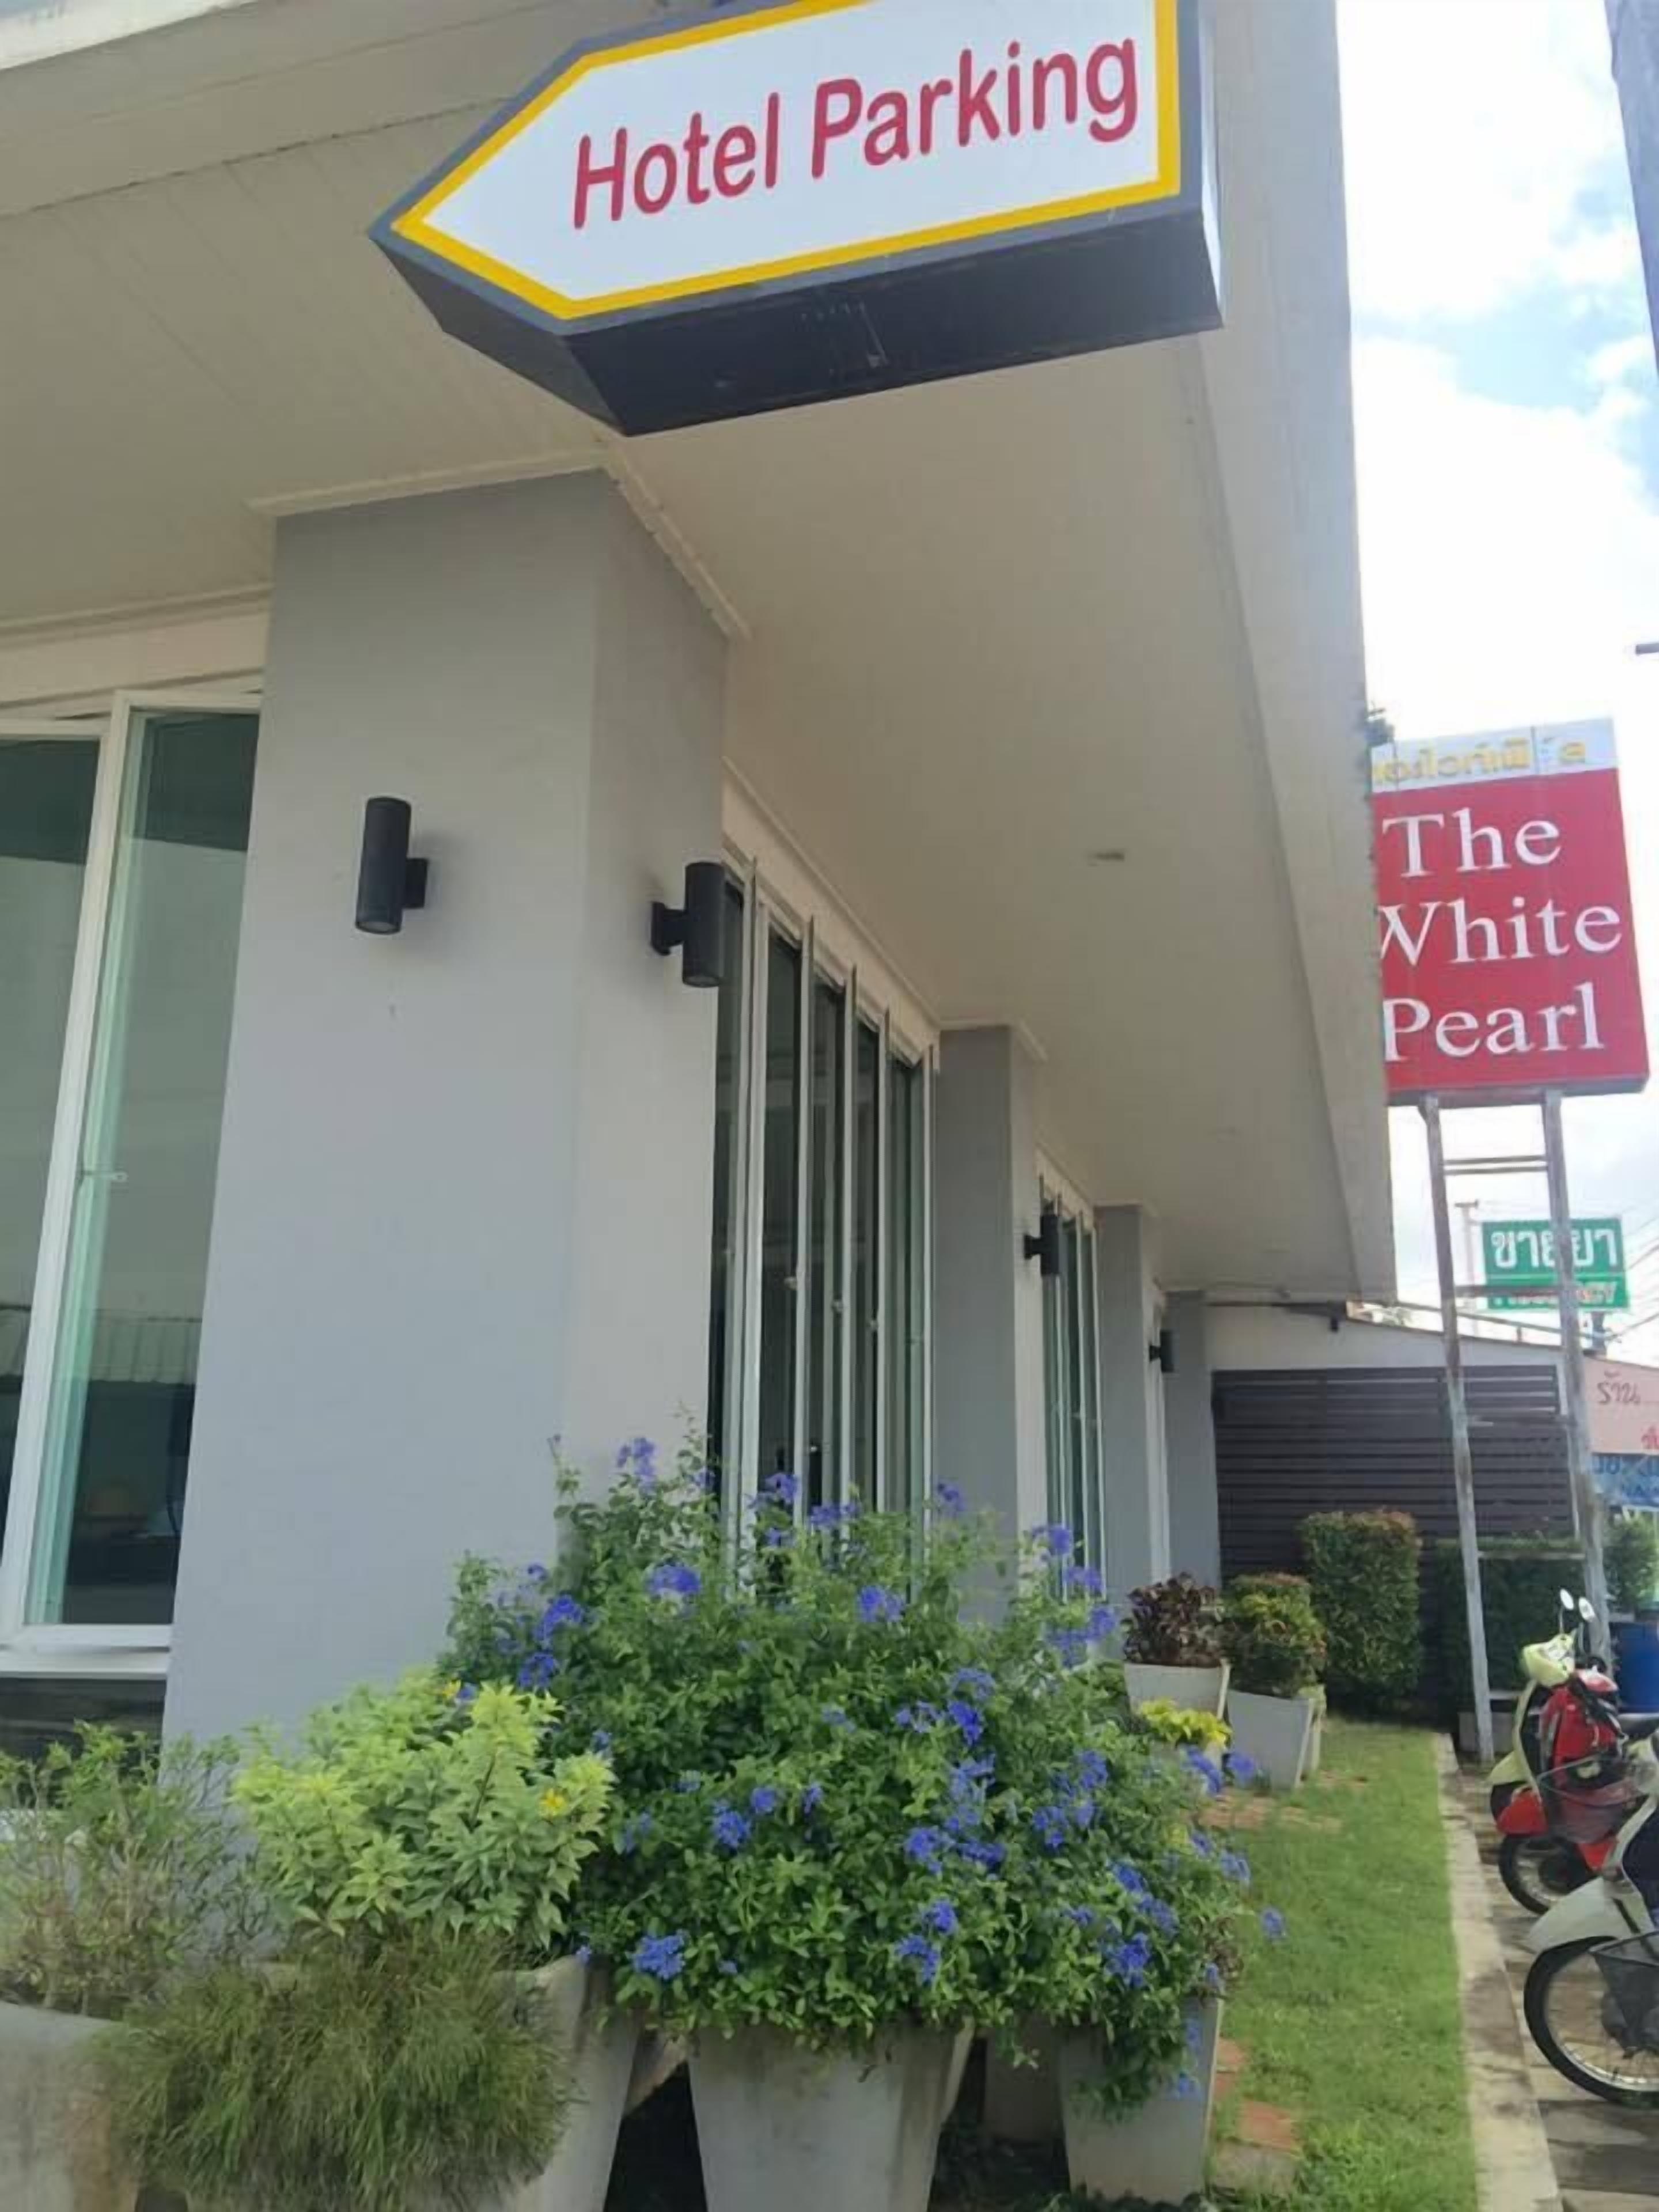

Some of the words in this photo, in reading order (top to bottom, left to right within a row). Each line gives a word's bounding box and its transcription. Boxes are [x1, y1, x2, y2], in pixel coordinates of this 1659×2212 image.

[574, 91, 781, 229] Hotel
[810, 37, 1139, 179] Parking
[1382, 808, 1561, 878] The
[1382, 981, 1605, 1062] Pearl
